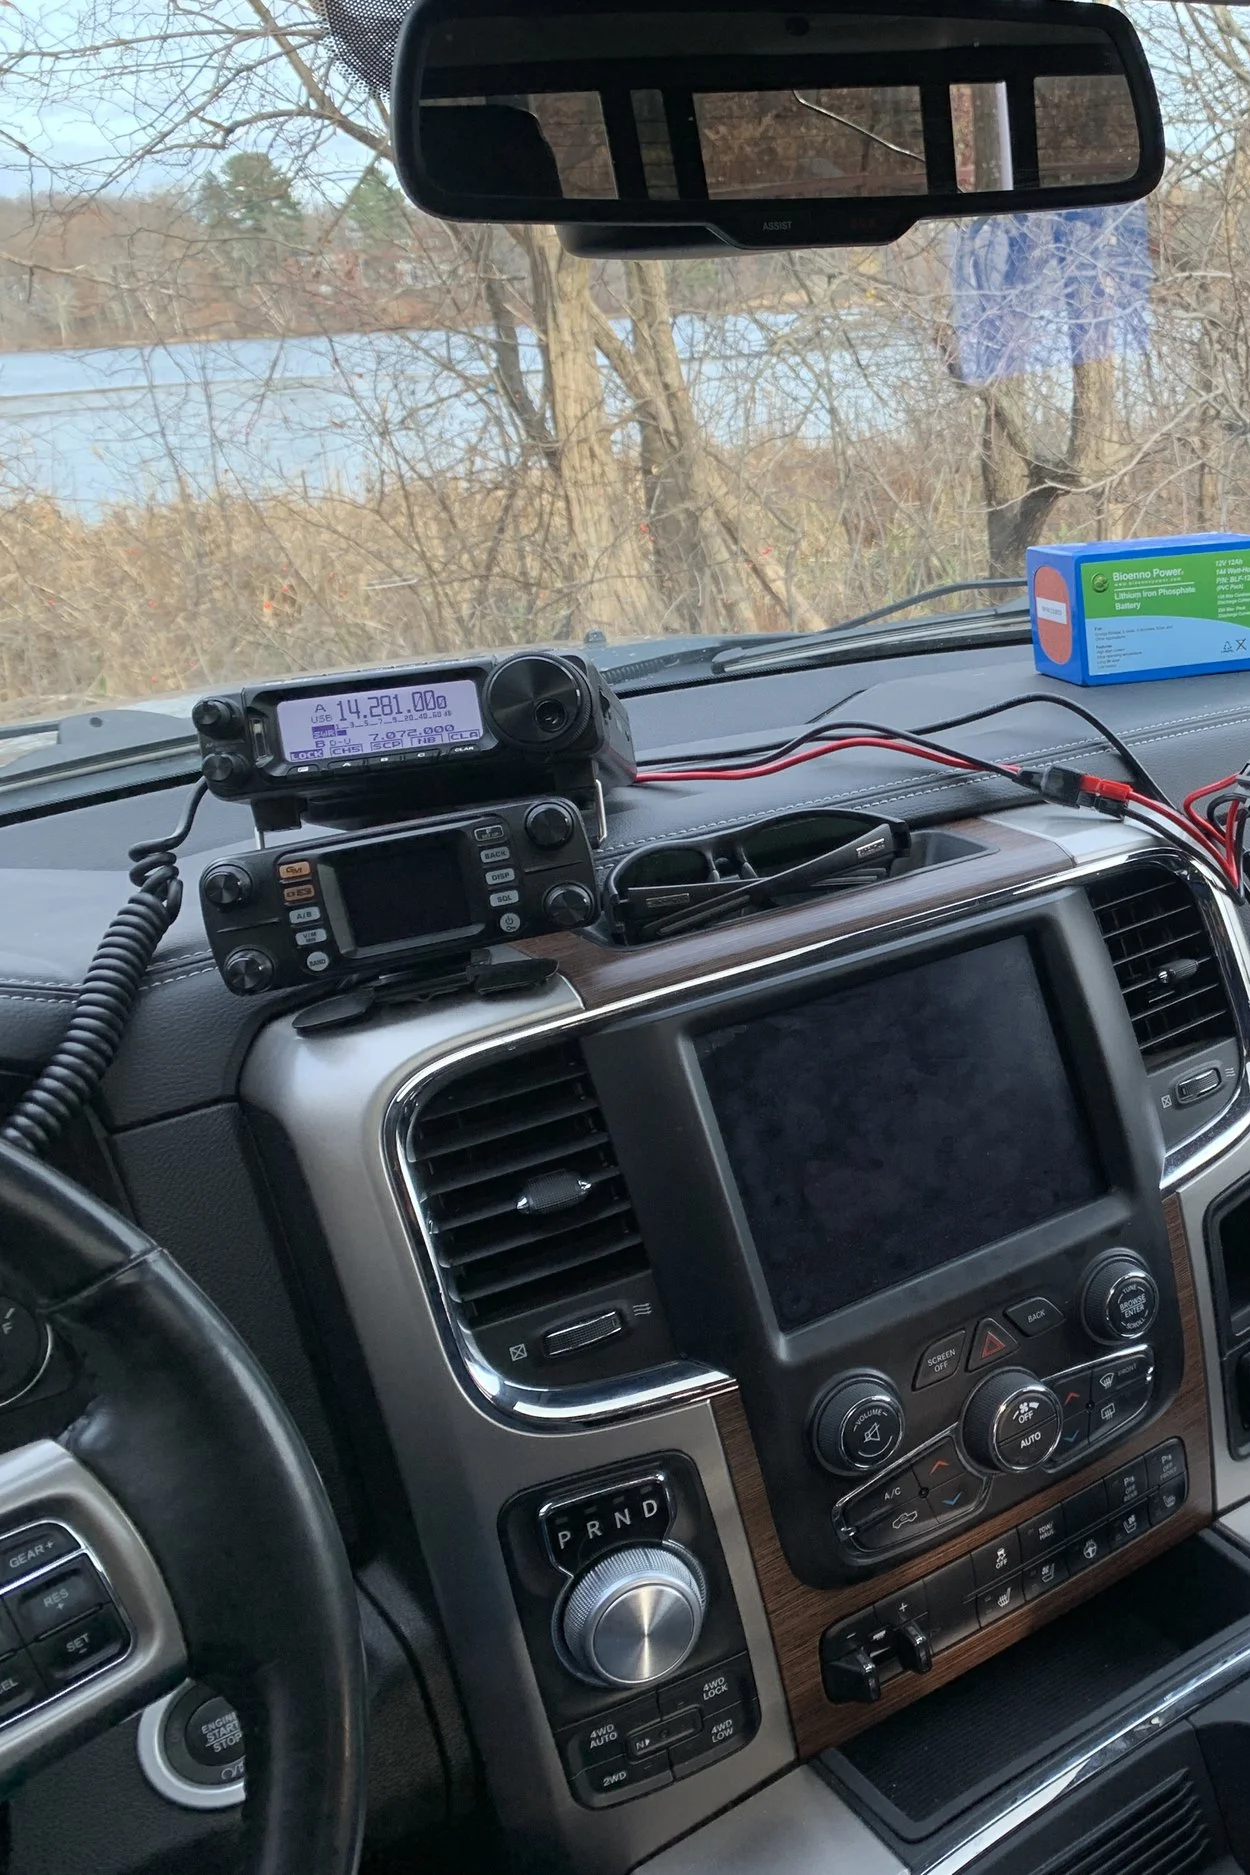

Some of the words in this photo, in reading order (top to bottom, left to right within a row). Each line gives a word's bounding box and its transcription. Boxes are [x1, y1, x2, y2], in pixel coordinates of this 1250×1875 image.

[763, 221, 792, 231] ASSIST
[1113, 571, 1151, 581] Bioenno
[1153, 568, 1182, 577] Power
[1114, 591, 1141, 600] Lithium
[1158, 586, 1195, 596] Phosphate
[1115, 602, 1141, 610] Battery
[315, 703, 327, 713] A
[336, 690, 447, 722] 14.281.000
[311, 715, 333, 724] USB
[313, 730, 336, 739] SWR
[369, 724, 455, 741] 7.072.000
[451, 732, 479, 741] CLA
[332, 747, 361, 756] CHS
[372, 741, 401, 750] SCP
[291, 751, 324, 761] LOCK
[485, 850, 507, 860] BACK
[491, 872, 510, 881] DISP
[297, 911, 312, 920] A/B
[1122, 1284, 1137, 1294] TUNE
[1120, 1293, 1147, 1310] BROWSE
[1027, 1309, 1046, 1323] BACK
[1124, 1303, 1145, 1318] ENTER
[927, 1349, 956, 1367] SCREEN
[934, 1360, 948, 1373] OFF
[855, 1408, 883, 1427] VOLUME
[1018, 1410, 1034, 1424] OFF
[1020, 1431, 1042, 1449] AUTO
[884, 1487, 902, 1501] A/C
[558, 1530, 572, 1550] P
[586, 1520, 602, 1540] R
[615, 1508, 631, 1530] N
[643, 1499, 658, 1518] D
[995, 1558, 1008, 1570] OFF
[43, 1588, 69, 1607] RES
[66, 1633, 90, 1652] SET
[702, 1675, 726, 1694] 4WD
[703, 1683, 729, 1701] LOCK
[206, 1720, 240, 1742] START
[590, 1723, 615, 1740] 4WD
[711, 1718, 733, 1736] 4WD
[589, 1731, 619, 1750] AUTO
[711, 1725, 734, 1744] LOW
[213, 1731, 242, 1753] STOP
[603, 1770, 628, 1788] 2WD
